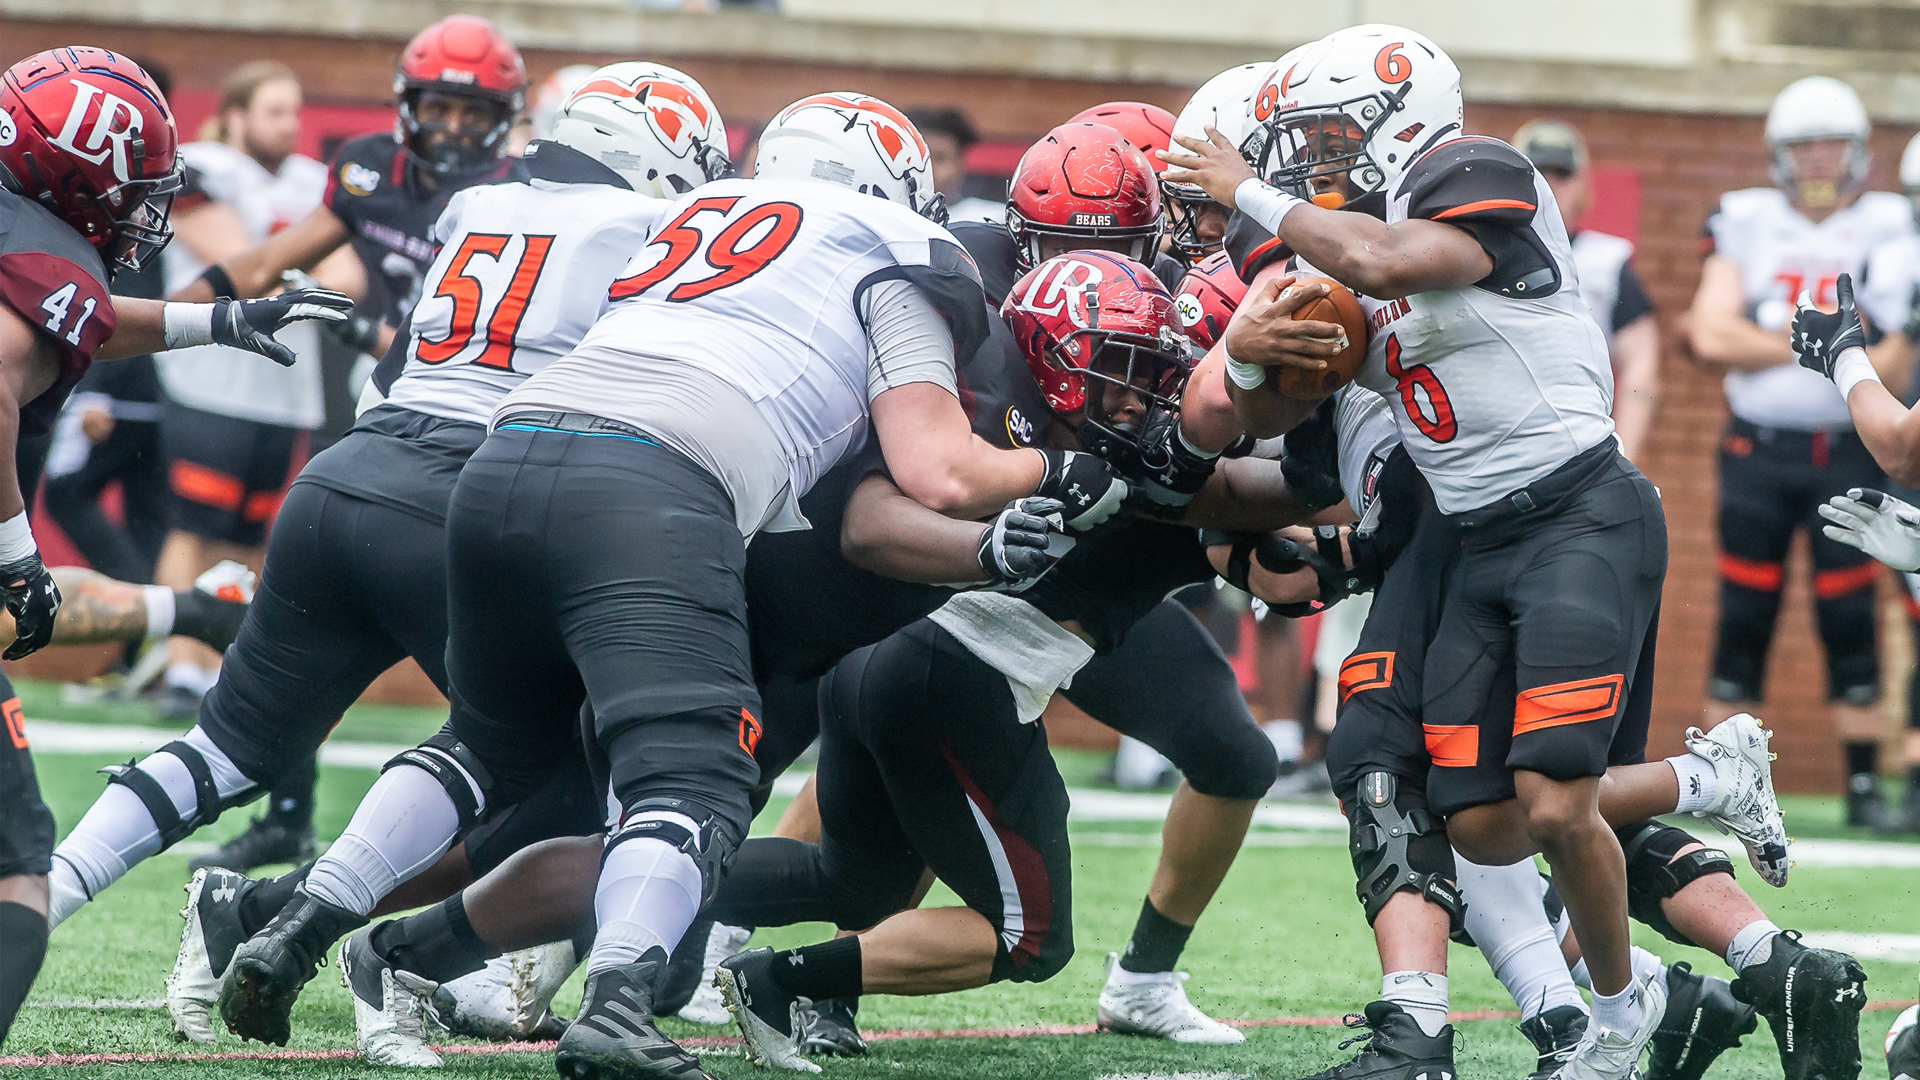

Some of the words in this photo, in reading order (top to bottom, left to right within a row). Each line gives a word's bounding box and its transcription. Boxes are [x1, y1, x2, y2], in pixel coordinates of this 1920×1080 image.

[1373, 41, 1413, 84] 6
[46, 78, 145, 183] LR
[608, 195, 805, 303] 59
[1075, 214, 1112, 227] BEARS
[39, 280, 98, 347] 41
[415, 231, 557, 373] 51
[1017, 257, 1103, 329] LR
[1177, 300, 1198, 320] SAC
[1384, 331, 1458, 444] 6
[1009, 408, 1034, 443] SAC
[1785, 966, 1797, 1017] ARMOUR
[1786, 1017, 1795, 1053] UNDER
